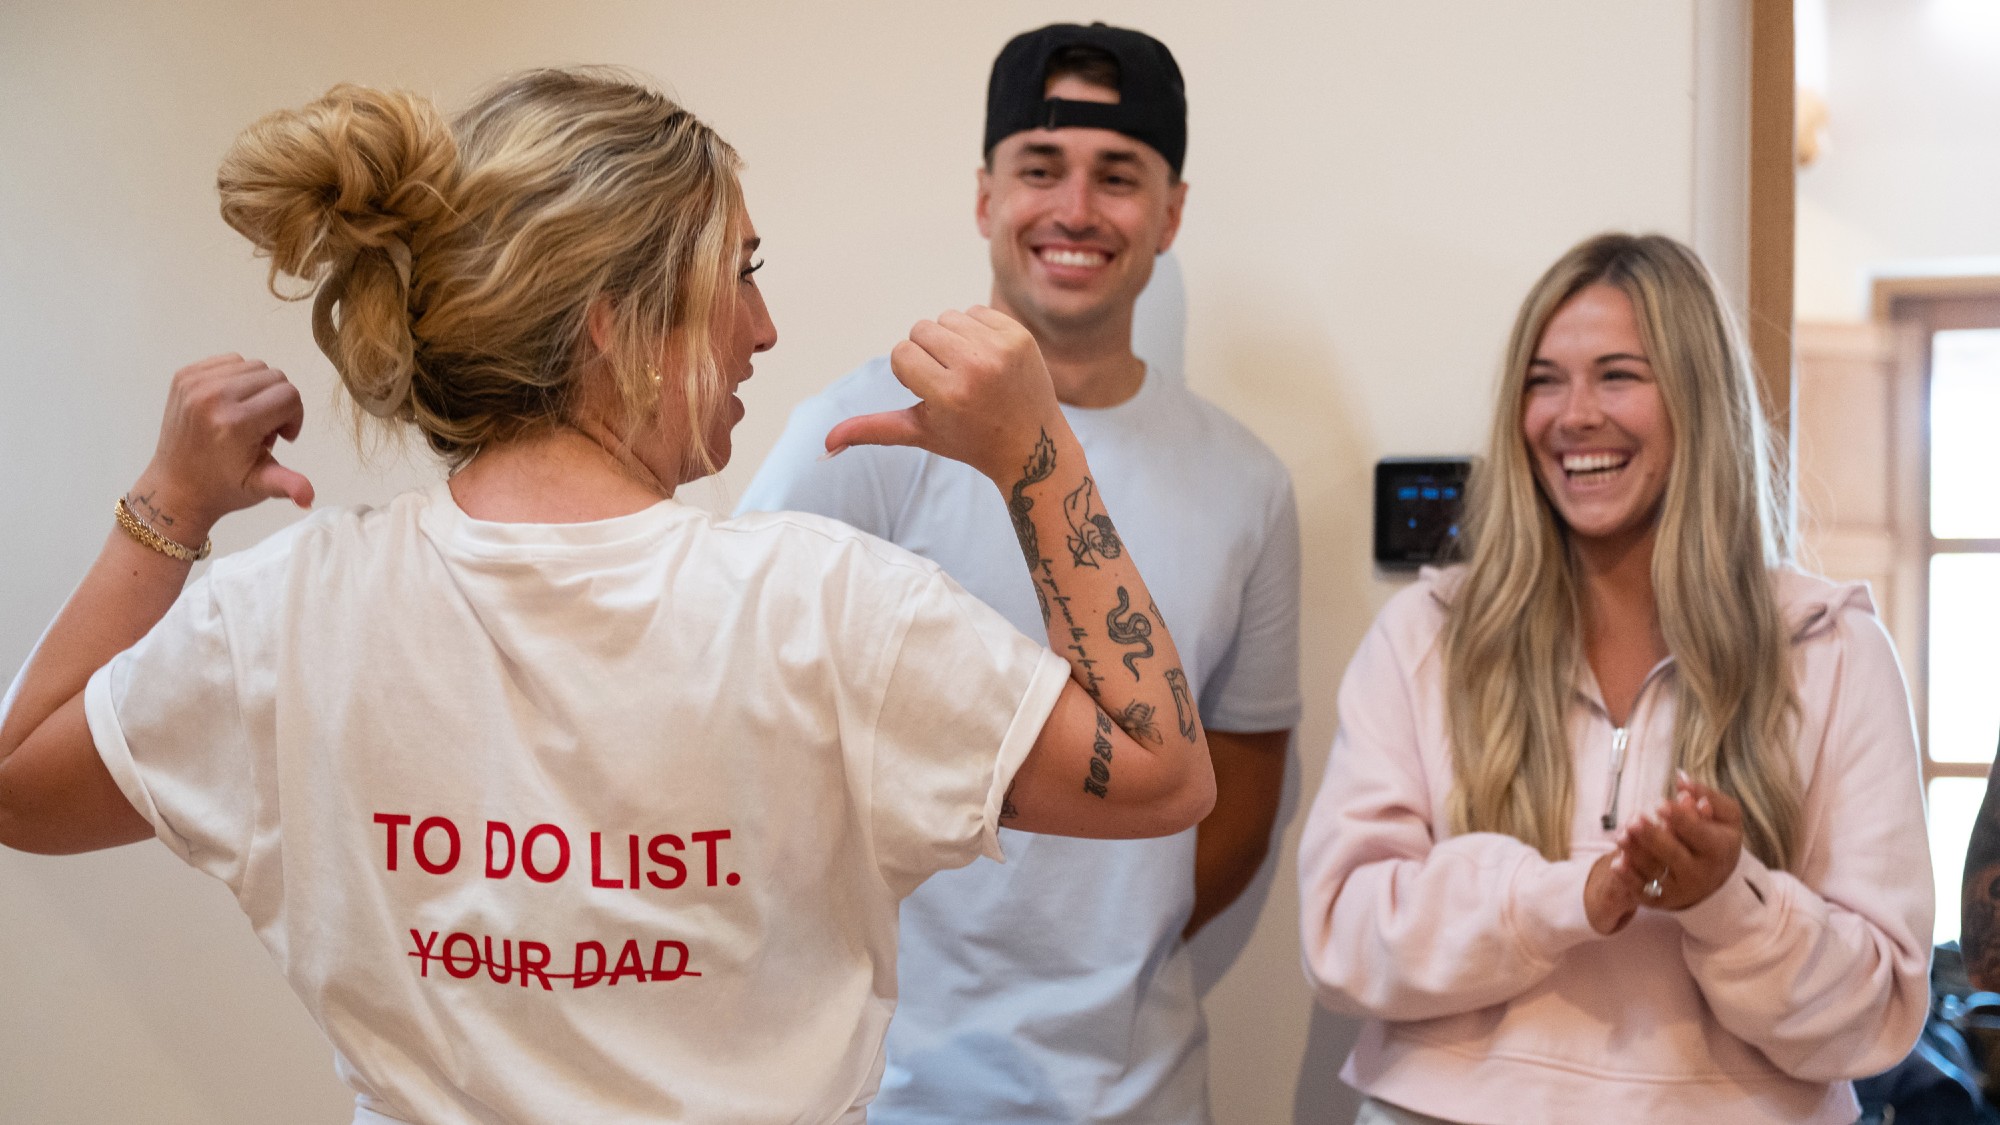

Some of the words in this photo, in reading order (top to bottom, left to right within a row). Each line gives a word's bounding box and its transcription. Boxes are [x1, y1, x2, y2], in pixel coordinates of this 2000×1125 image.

[373, 813, 461, 875] TO
[485, 820, 570, 883] DO
[590, 829, 741, 889] LIST.
[409, 929, 553, 991] YOUR
[573, 939, 692, 989] DAD
